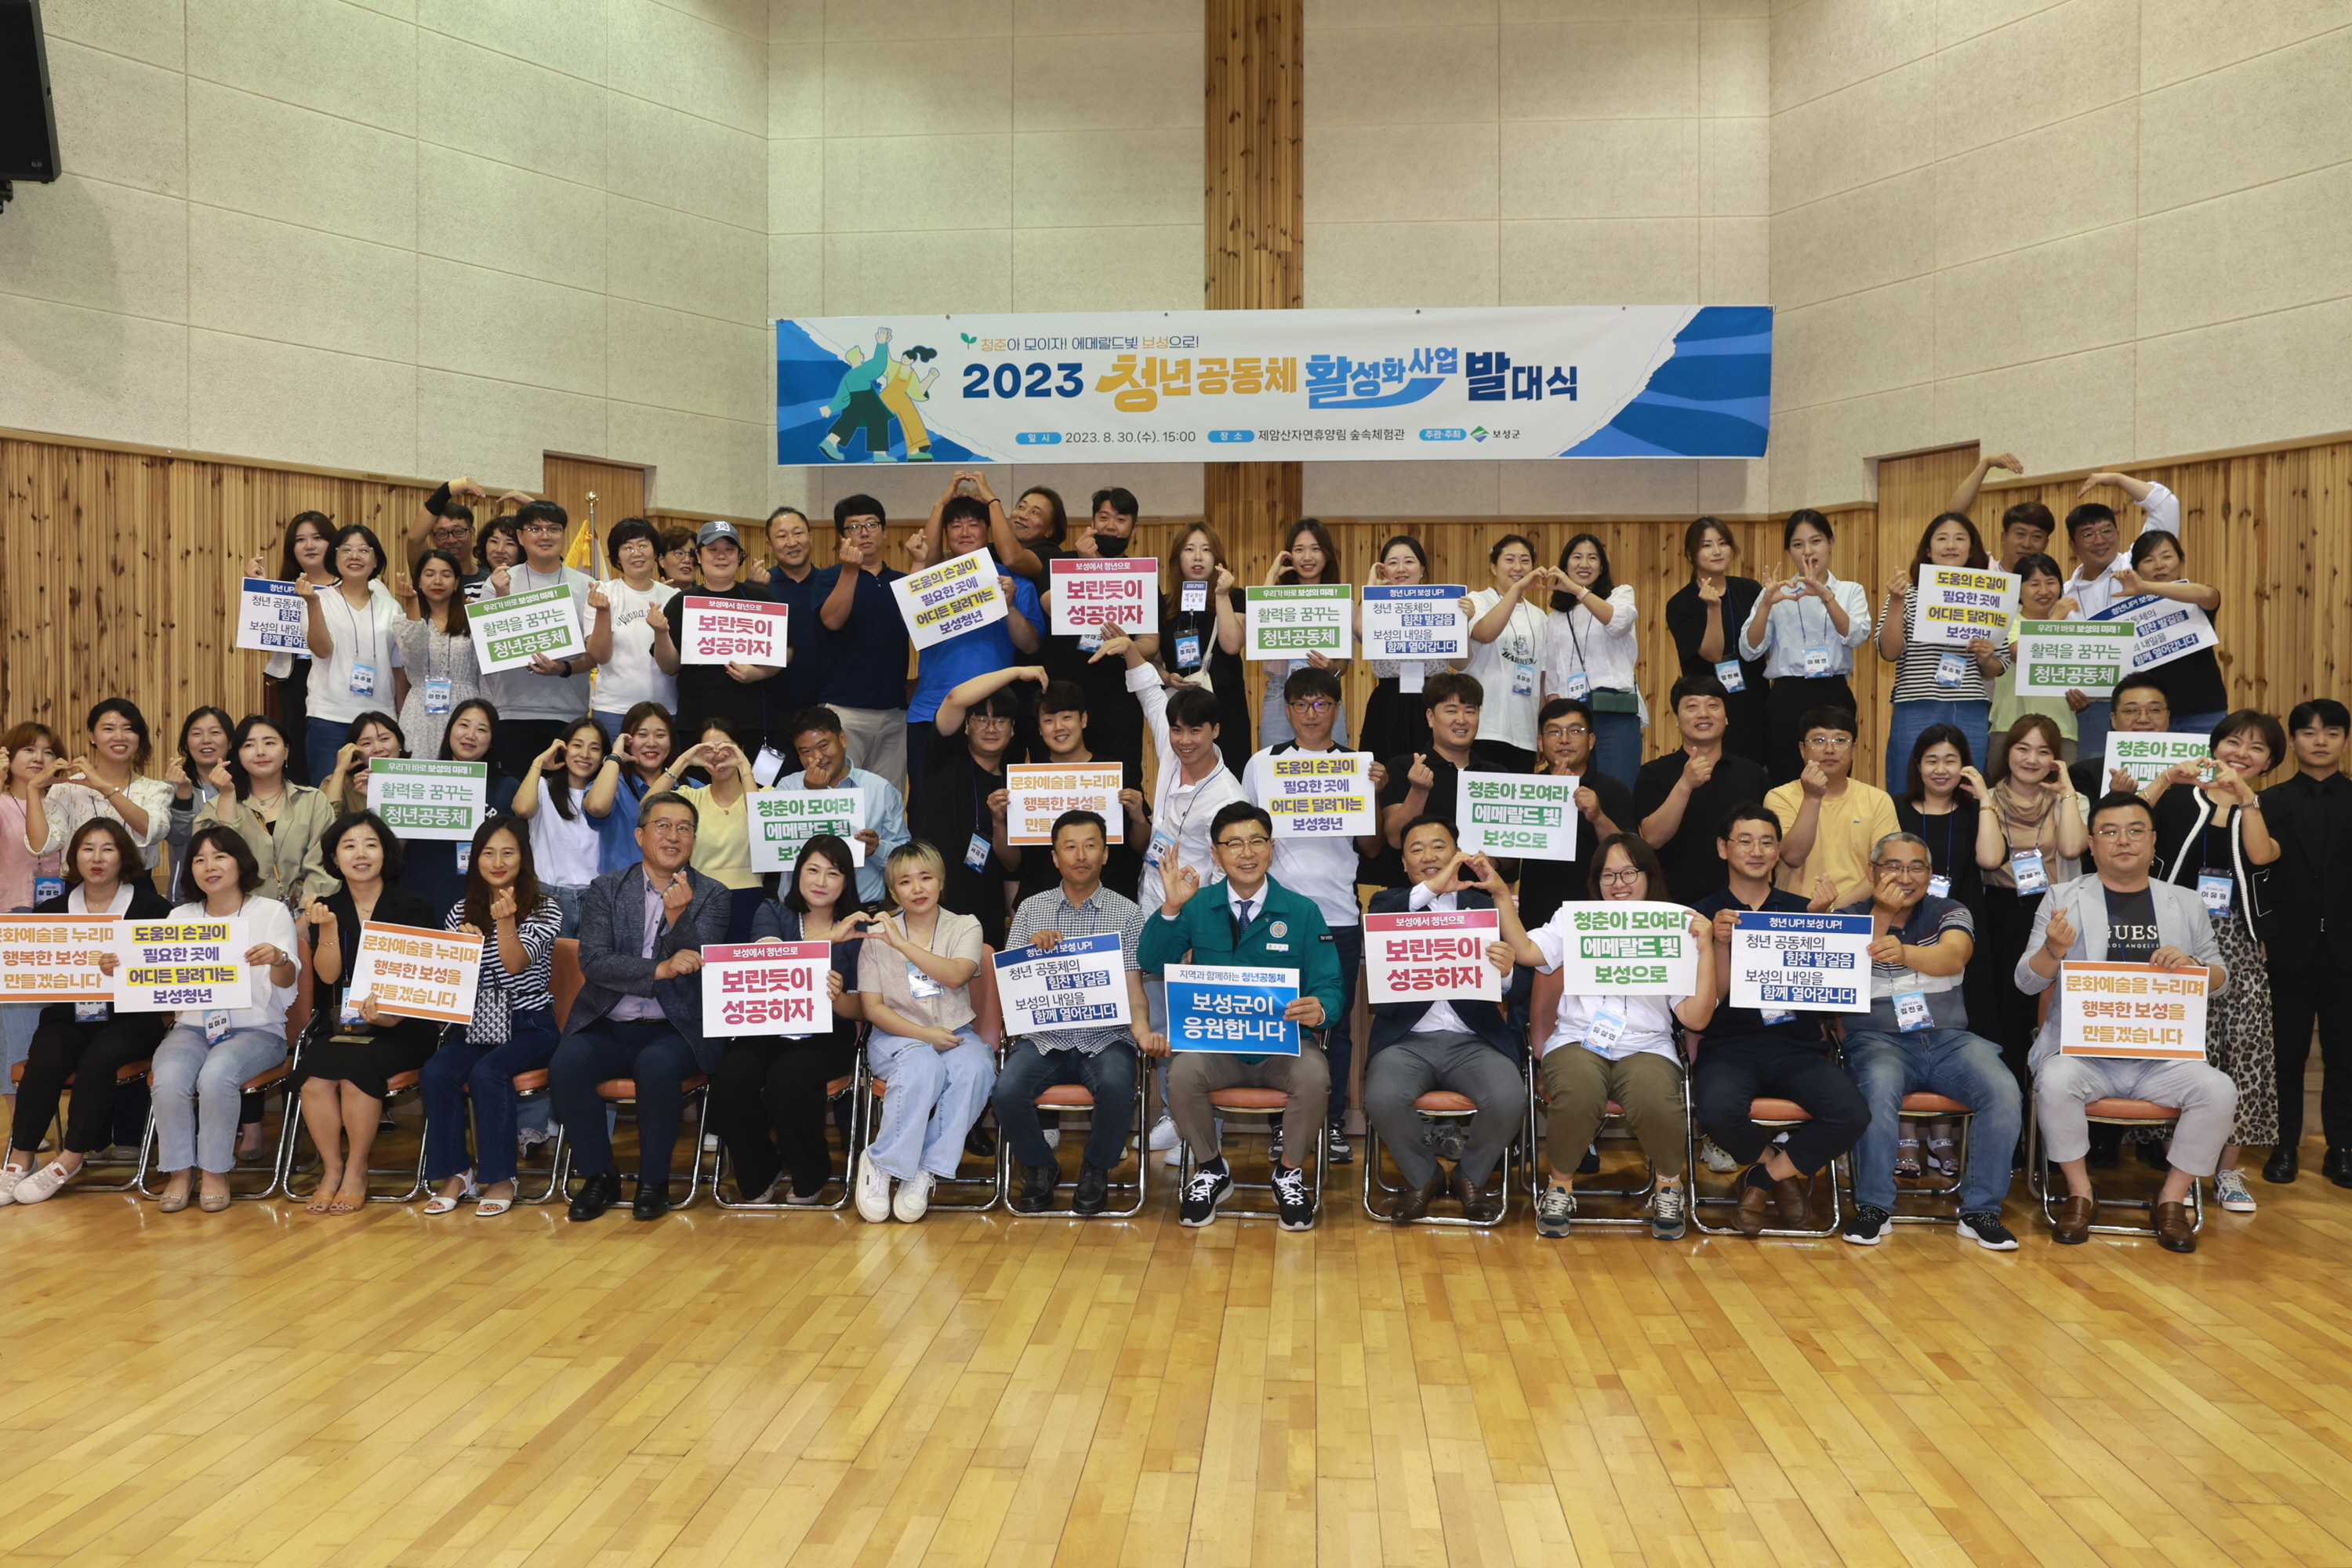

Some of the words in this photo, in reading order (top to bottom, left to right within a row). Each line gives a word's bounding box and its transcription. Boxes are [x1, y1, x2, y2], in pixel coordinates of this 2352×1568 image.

[981, 338, 1020, 351] 청춘아
[1025, 338, 1067, 350] 모이자!
[1072, 336, 1138, 350] 에메랄드빛
[1142, 336, 1199, 349] 보성으로!
[963, 363, 1083, 398] 2023
[1094, 354, 1297, 412] 청년공동체
[1466, 352, 1577, 401] 발대식
[1163, 431, 1196, 442] 15:00
[1258, 430, 1346, 441] 제암산자연휴양림
[1350, 430, 1405, 441] 숲속체험관
[1493, 430, 1520, 439] 보성군
[909, 572, 943, 592] 도움의
[944, 559, 977, 579] 손길이
[1937, 572, 1973, 586] 도움의
[1975, 575, 2005, 591] 손길이
[1067, 580, 1142, 600] 보란듯이
[1943, 590, 1977, 604] 필요한
[1980, 594, 2000, 608] 곳에
[950, 590, 994, 613] 달려가는
[1373, 603, 1392, 614] 청년
[1395, 603, 1432, 613] 공동체의
[281, 610, 299, 622] 힘찬
[484, 616, 522, 637] 활력을
[526, 608, 565, 627] 꿈꾸는
[939, 610, 983, 634] 보성청년
[1067, 604, 1143, 625] 성공하자
[1258, 608, 1297, 622] 활력을
[1301, 607, 1340, 621] 꿈꾸는
[1403, 615, 1422, 626] 힘찬
[1425, 614, 1453, 625] 발걸음
[1929, 607, 1964, 621] 어디든
[1967, 610, 2005, 626] 달려가는
[2158, 612, 2185, 628] 발걸음
[249, 621, 278, 633] 보성의
[699, 615, 772, 637] 보란듯이
[494, 629, 567, 658] 청년공동체
[1263, 629, 1335, 647] 청년공동체
[1374, 630, 1401, 641] 보성의
[1405, 630, 1432, 640] 내일을
[697, 637, 772, 657] 성공하자
[1387, 641, 1406, 652] 함께
[1409, 641, 1456, 652] 열어갑니다
[2031, 643, 2074, 659] 활력을
[2078, 644, 2122, 659] 꿈꾸는
[2153, 635, 2196, 658] 열어갑니다
[2034, 666, 2114, 684] 청년공동체
[2117, 741, 2167, 757] 청춘아
[1277, 761, 1314, 774] 도움의
[1316, 760, 1354, 773] 손길이
[381, 782, 425, 799] 활력을
[430, 785, 473, 800] 꿈꾸는
[1011, 775, 1076, 789] 문화예술을
[1080, 775, 1120, 788] 누리며
[1284, 780, 1322, 794] 필요한
[1324, 779, 1349, 792] 곳에
[1468, 781, 1516, 800] 청춘아
[1519, 785, 1569, 802] 모여라
[757, 800, 804, 817] 청춘아
[808, 798, 855, 815] 모여라
[1024, 797, 1064, 811] 행복한
[1272, 800, 1308, 813] 어디든
[1312, 798, 1362, 811] 달려가는
[386, 806, 467, 826] 청년공동체
[1293, 818, 1343, 831] 보성청년
[1475, 805, 1539, 823] 에메랄드
[1543, 808, 1559, 826] 빛
[1483, 830, 1548, 848] 보성으로
[1396, 917, 1429, 927] 보성에서
[1432, 916, 1465, 925] 청년으로
[1574, 912, 1628, 930] 청춘아
[1632, 912, 1687, 930] 모여라
[1769, 918, 1787, 927] 청년
[1788, 919, 1805, 927] UP!
[1806, 920, 1824, 929] 보성
[1826, 920, 1842, 929] UP!
[135, 927, 179, 941] 도움의
[183, 925, 226, 940] 손길이
[363, 935, 433, 958] 문화예술을
[436, 945, 479, 964] 누리며
[1077, 941, 1093, 949] UP!
[1386, 937, 1481, 962] 보란듯이
[1583, 938, 1656, 957] 에메랄드
[1660, 938, 1679, 956] 빛
[1747, 935, 1770, 949] 청년
[1775, 935, 1824, 950] 공동체의
[3, 951, 53, 966] 행복한
[143, 948, 187, 963] 필요한
[191, 947, 219, 961] 곳에
[733, 949, 764, 957] 보성에서
[767, 947, 798, 956] 청년으로
[1786, 951, 1811, 966] 힘찬
[1814, 953, 1853, 967] 발걸음
[129, 969, 172, 984] 어디든
[176, 967, 234, 982] 달려가는
[374, 960, 417, 979] 행복한
[1010, 965, 1032, 981] 청년
[1036, 959, 1080, 976] 공동체의
[1180, 971, 1204, 979] 지역과
[1207, 971, 1240, 982] 함께하는
[1242, 972, 1285, 983] 청년공동체
[1387, 966, 1483, 991] 성공하자
[1595, 966, 1668, 984] 보성으로
[1745, 970, 1782, 984] 보성의
[1787, 971, 1824, 985] 내일을
[4, 974, 101, 989] 만들겠습니다
[722, 967, 812, 993] 보란듯이
[1048, 975, 1070, 989] 힘찬
[1073, 971, 1107, 986] 발걸음
[2066, 976, 2147, 993] 문화예술을
[2152, 978, 2204, 996] 누리며
[154, 989, 212, 1004] 보성청년
[1015, 995, 1050, 1011] 보성의
[1052, 992, 1085, 1007] 내일을
[1763, 985, 1788, 1000] 함께
[1791, 987, 1855, 1003] 열어갑니다
[722, 998, 814, 1025] 성공하자
[1192, 993, 1273, 1015] 보성군이
[2082, 1000, 2132, 1018] 행복한
[2135, 1003, 2185, 1020] 보성을
[1034, 1010, 1058, 1024] 함께
[1060, 1004, 1116, 1021] 열어갑니다
[1183, 1017, 1286, 1042] 응원합니다
[2083, 1025, 2183, 1044] 만들겠습니다
